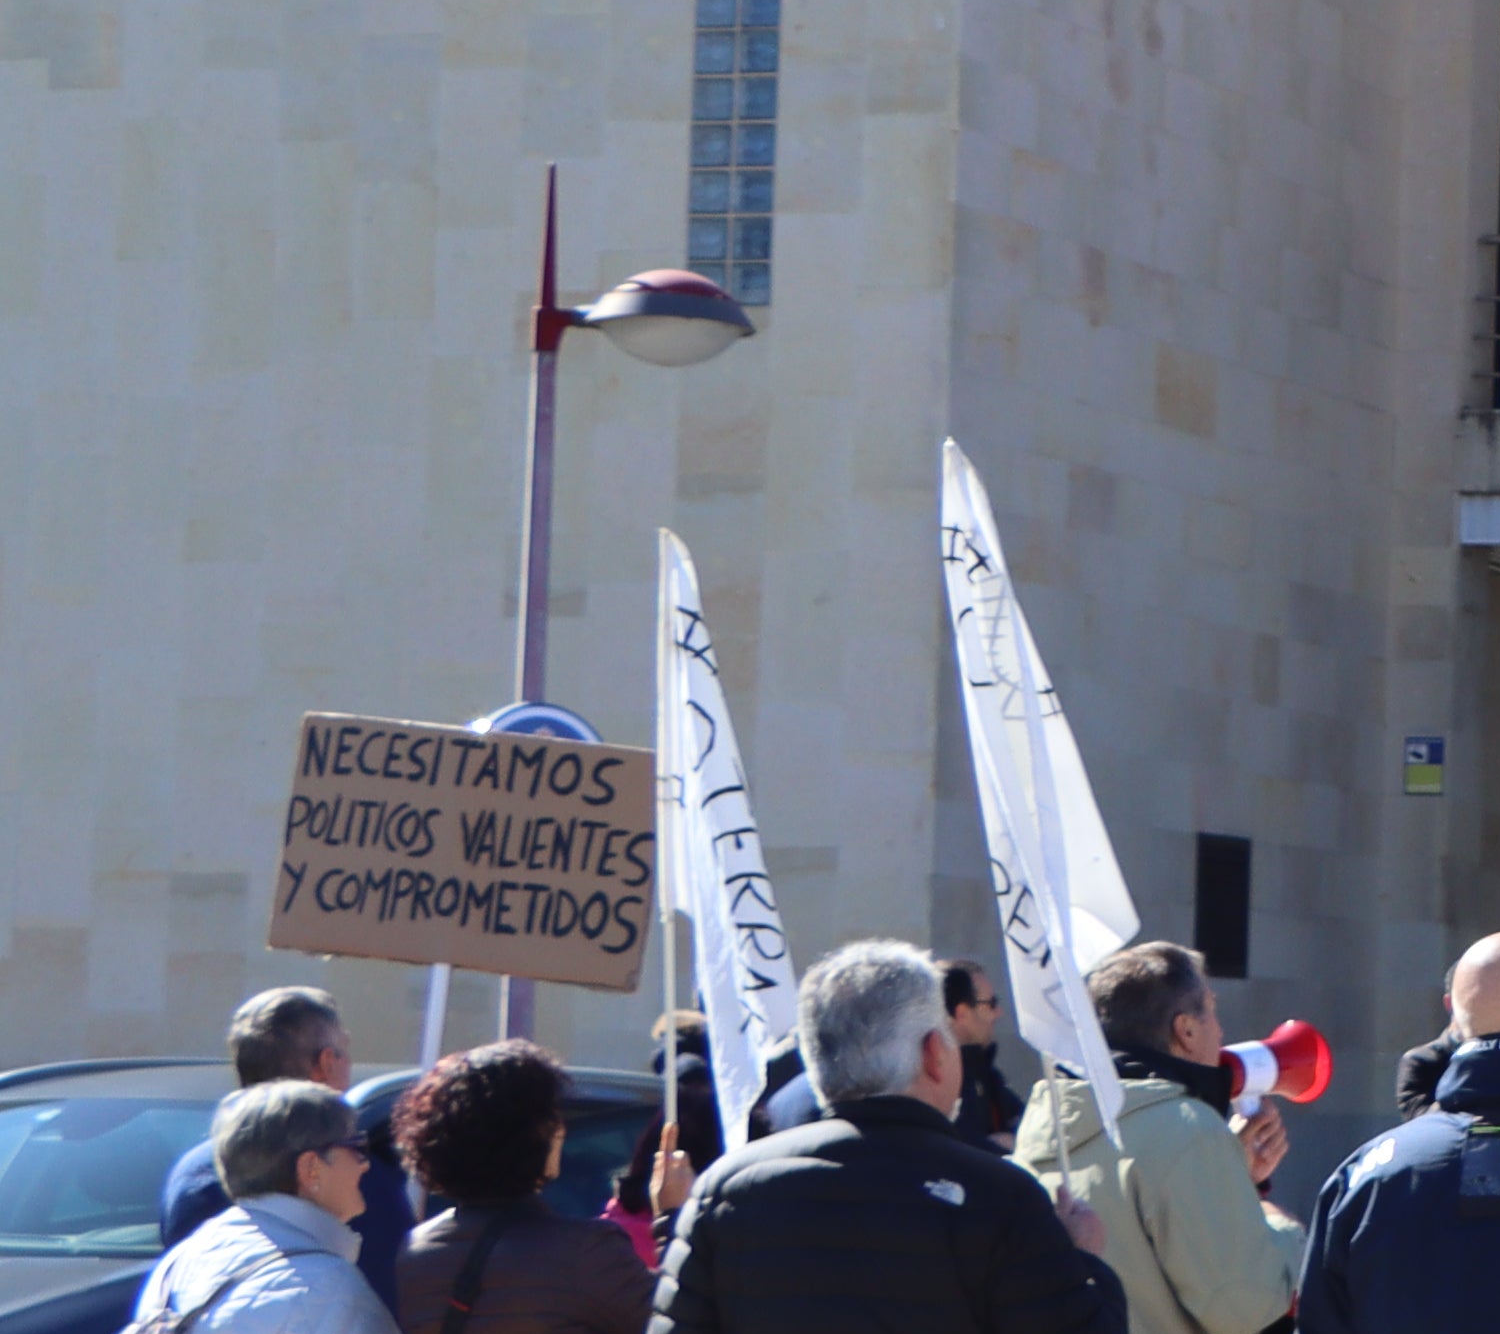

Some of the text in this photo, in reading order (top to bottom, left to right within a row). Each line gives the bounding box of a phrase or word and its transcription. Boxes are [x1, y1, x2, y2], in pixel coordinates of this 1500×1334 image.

[303, 725, 624, 806] NECESITAMOS
[284, 795, 654, 888] POLITICOS VALIENTES
[281, 860, 647, 956] Y COMPROMETIDOS
